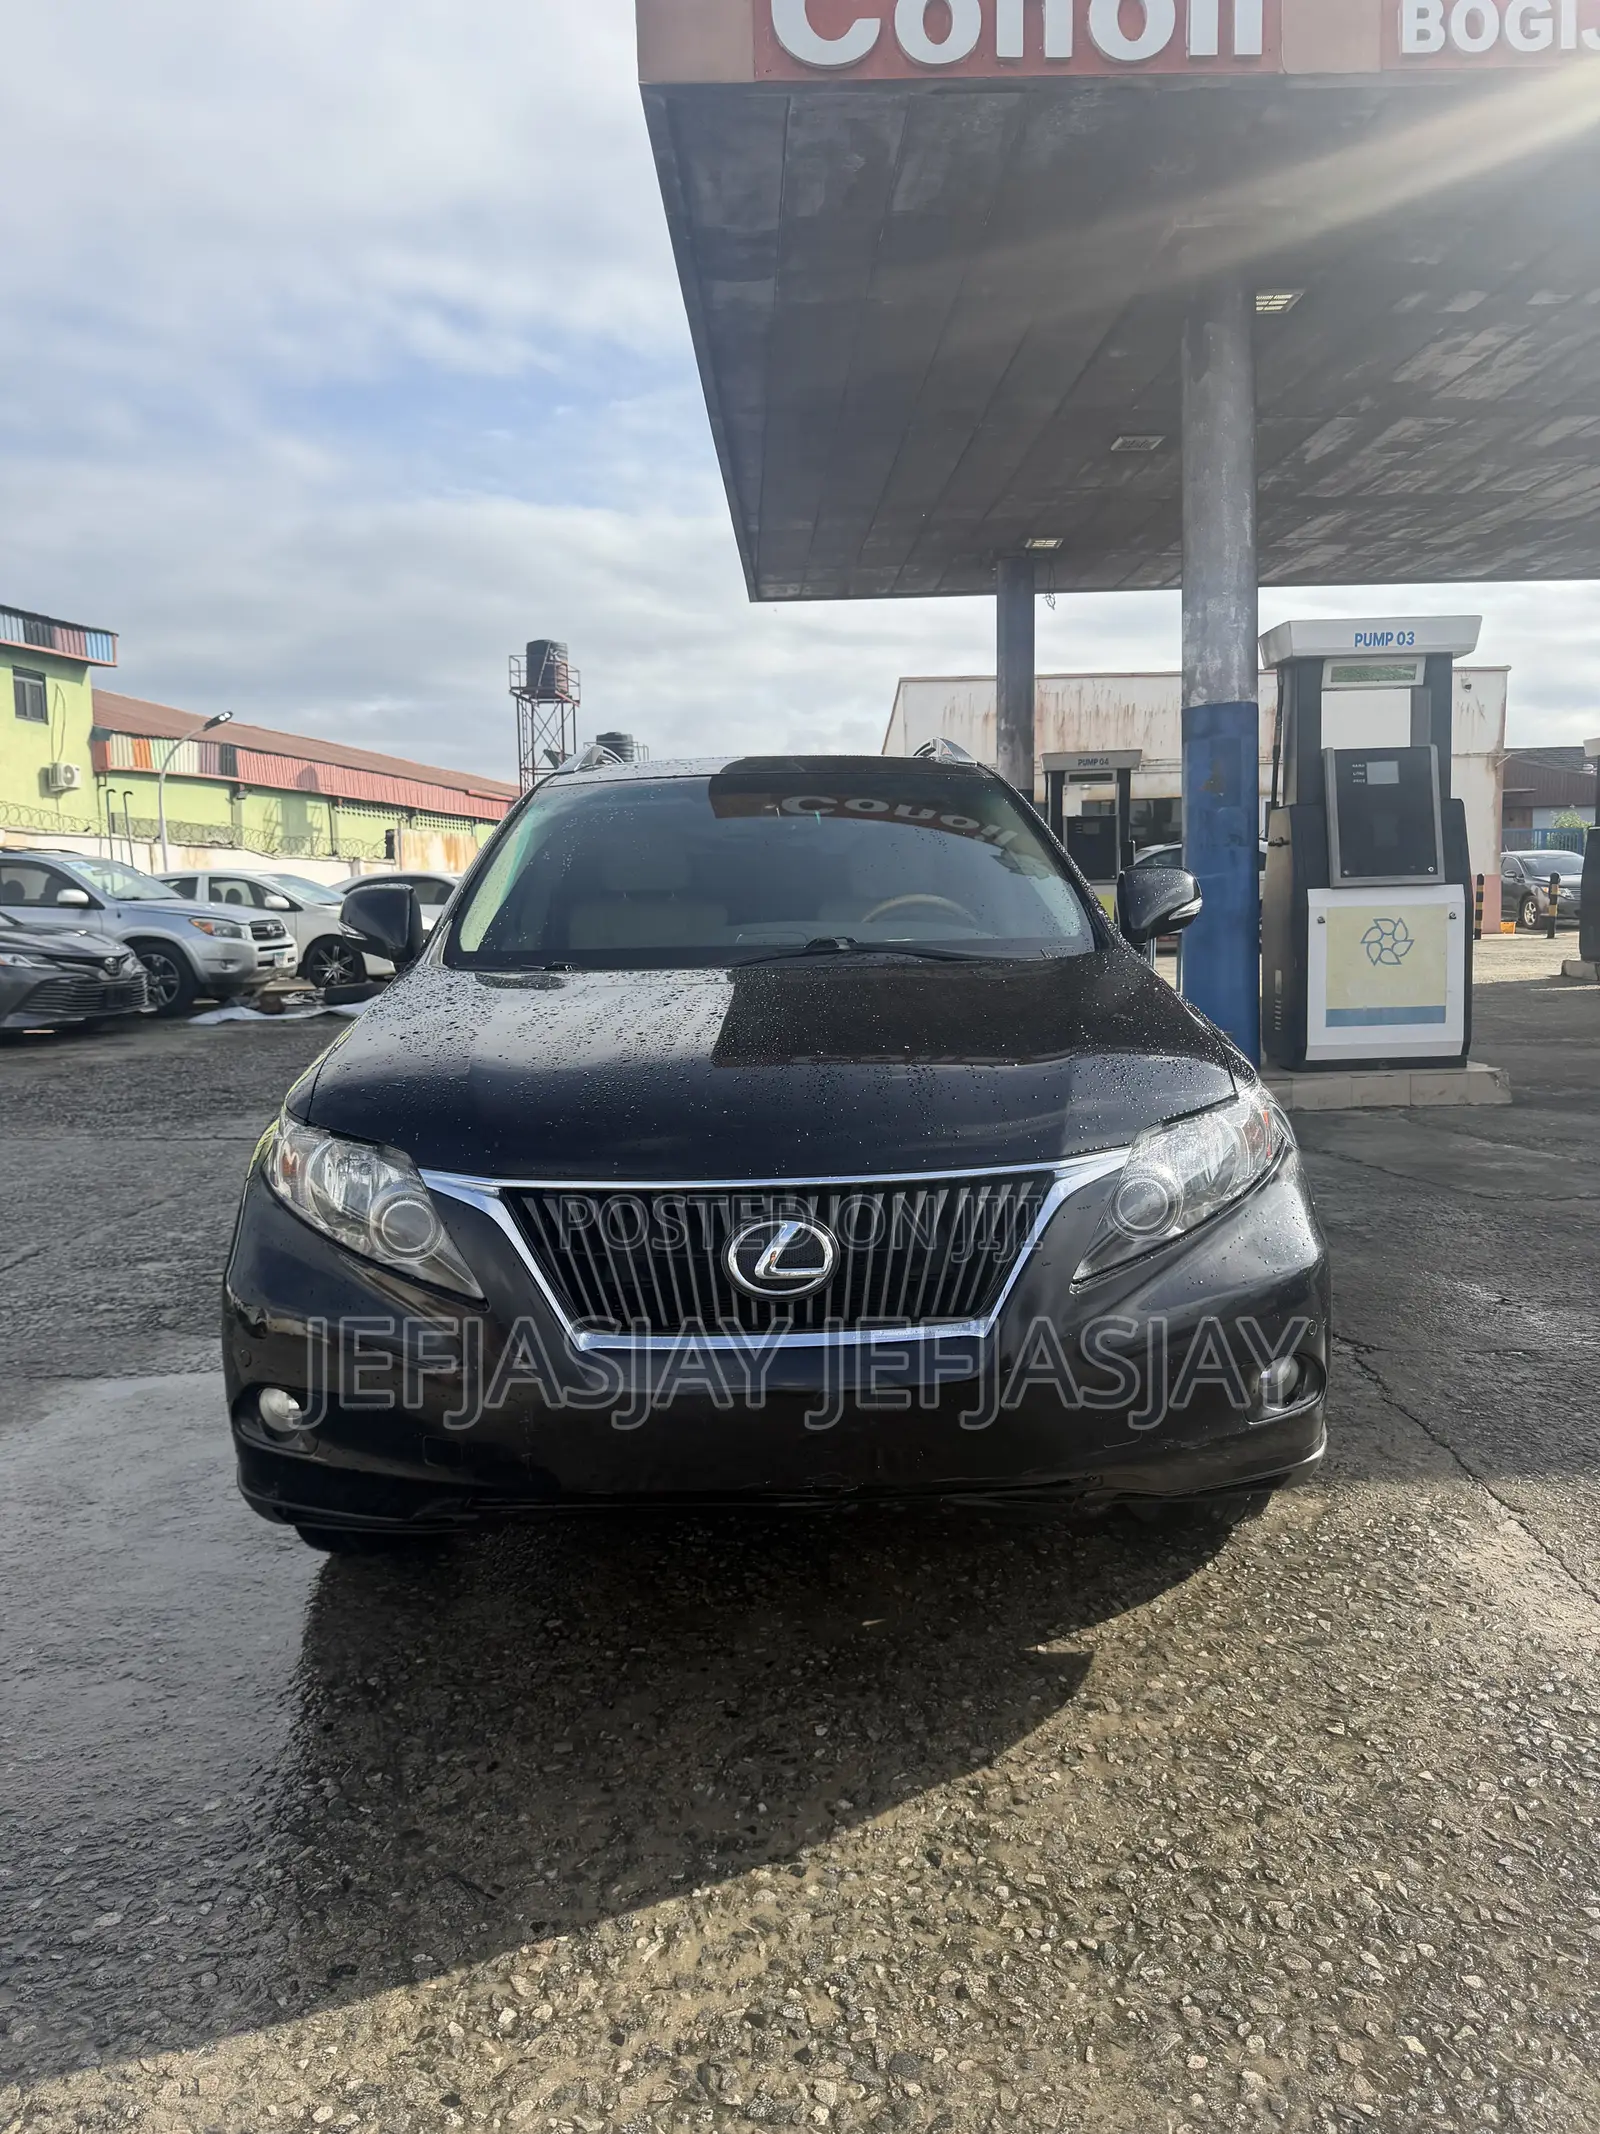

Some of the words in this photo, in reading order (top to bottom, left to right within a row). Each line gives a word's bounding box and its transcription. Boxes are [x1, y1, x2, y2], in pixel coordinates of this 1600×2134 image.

[1354, 632, 1394, 648] PUMP
[1396, 630, 1415, 646] 03
[1077, 758, 1099, 767] PUMP
